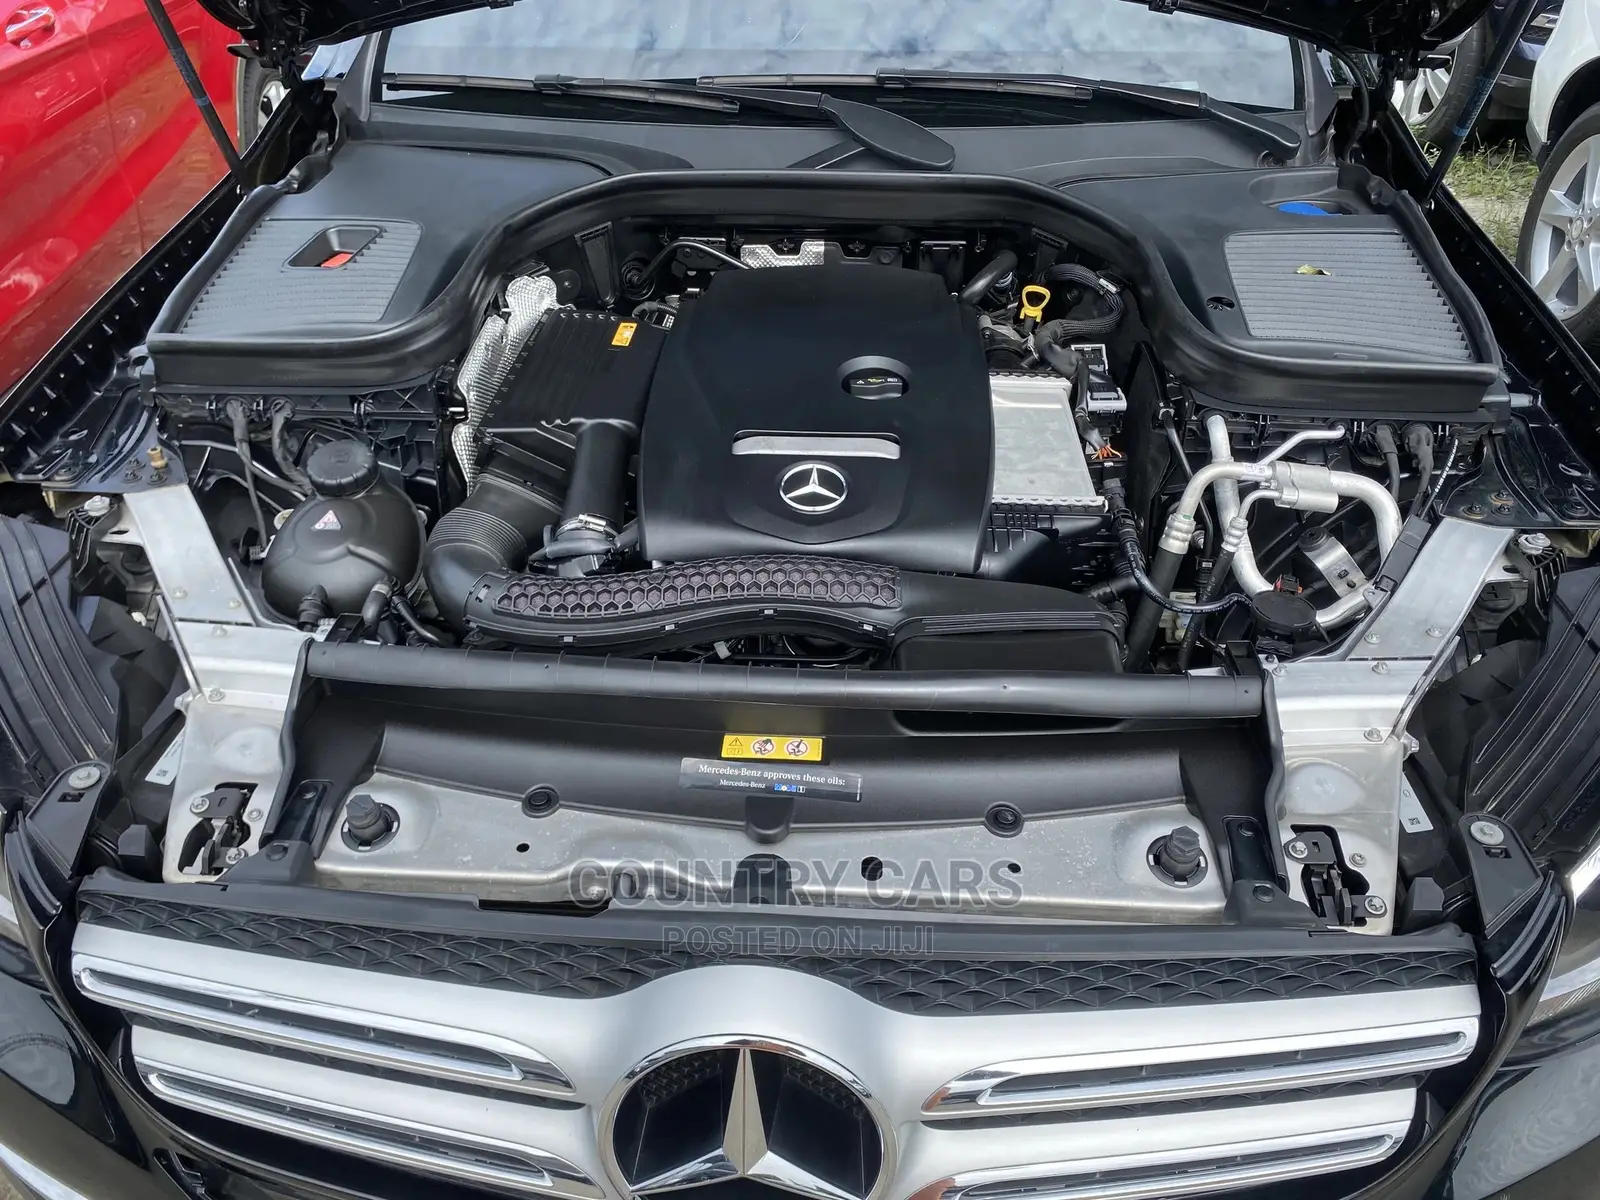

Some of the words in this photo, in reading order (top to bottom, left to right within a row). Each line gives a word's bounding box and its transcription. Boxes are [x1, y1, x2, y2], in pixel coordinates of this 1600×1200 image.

[698, 764, 762, 778] Mercedes-Benz
[763, 771, 801, 781] approves
[802, 773, 826, 784] these
[827, 776, 846, 786] oils:
[719, 779, 766, 789] Mercedes-Benz
